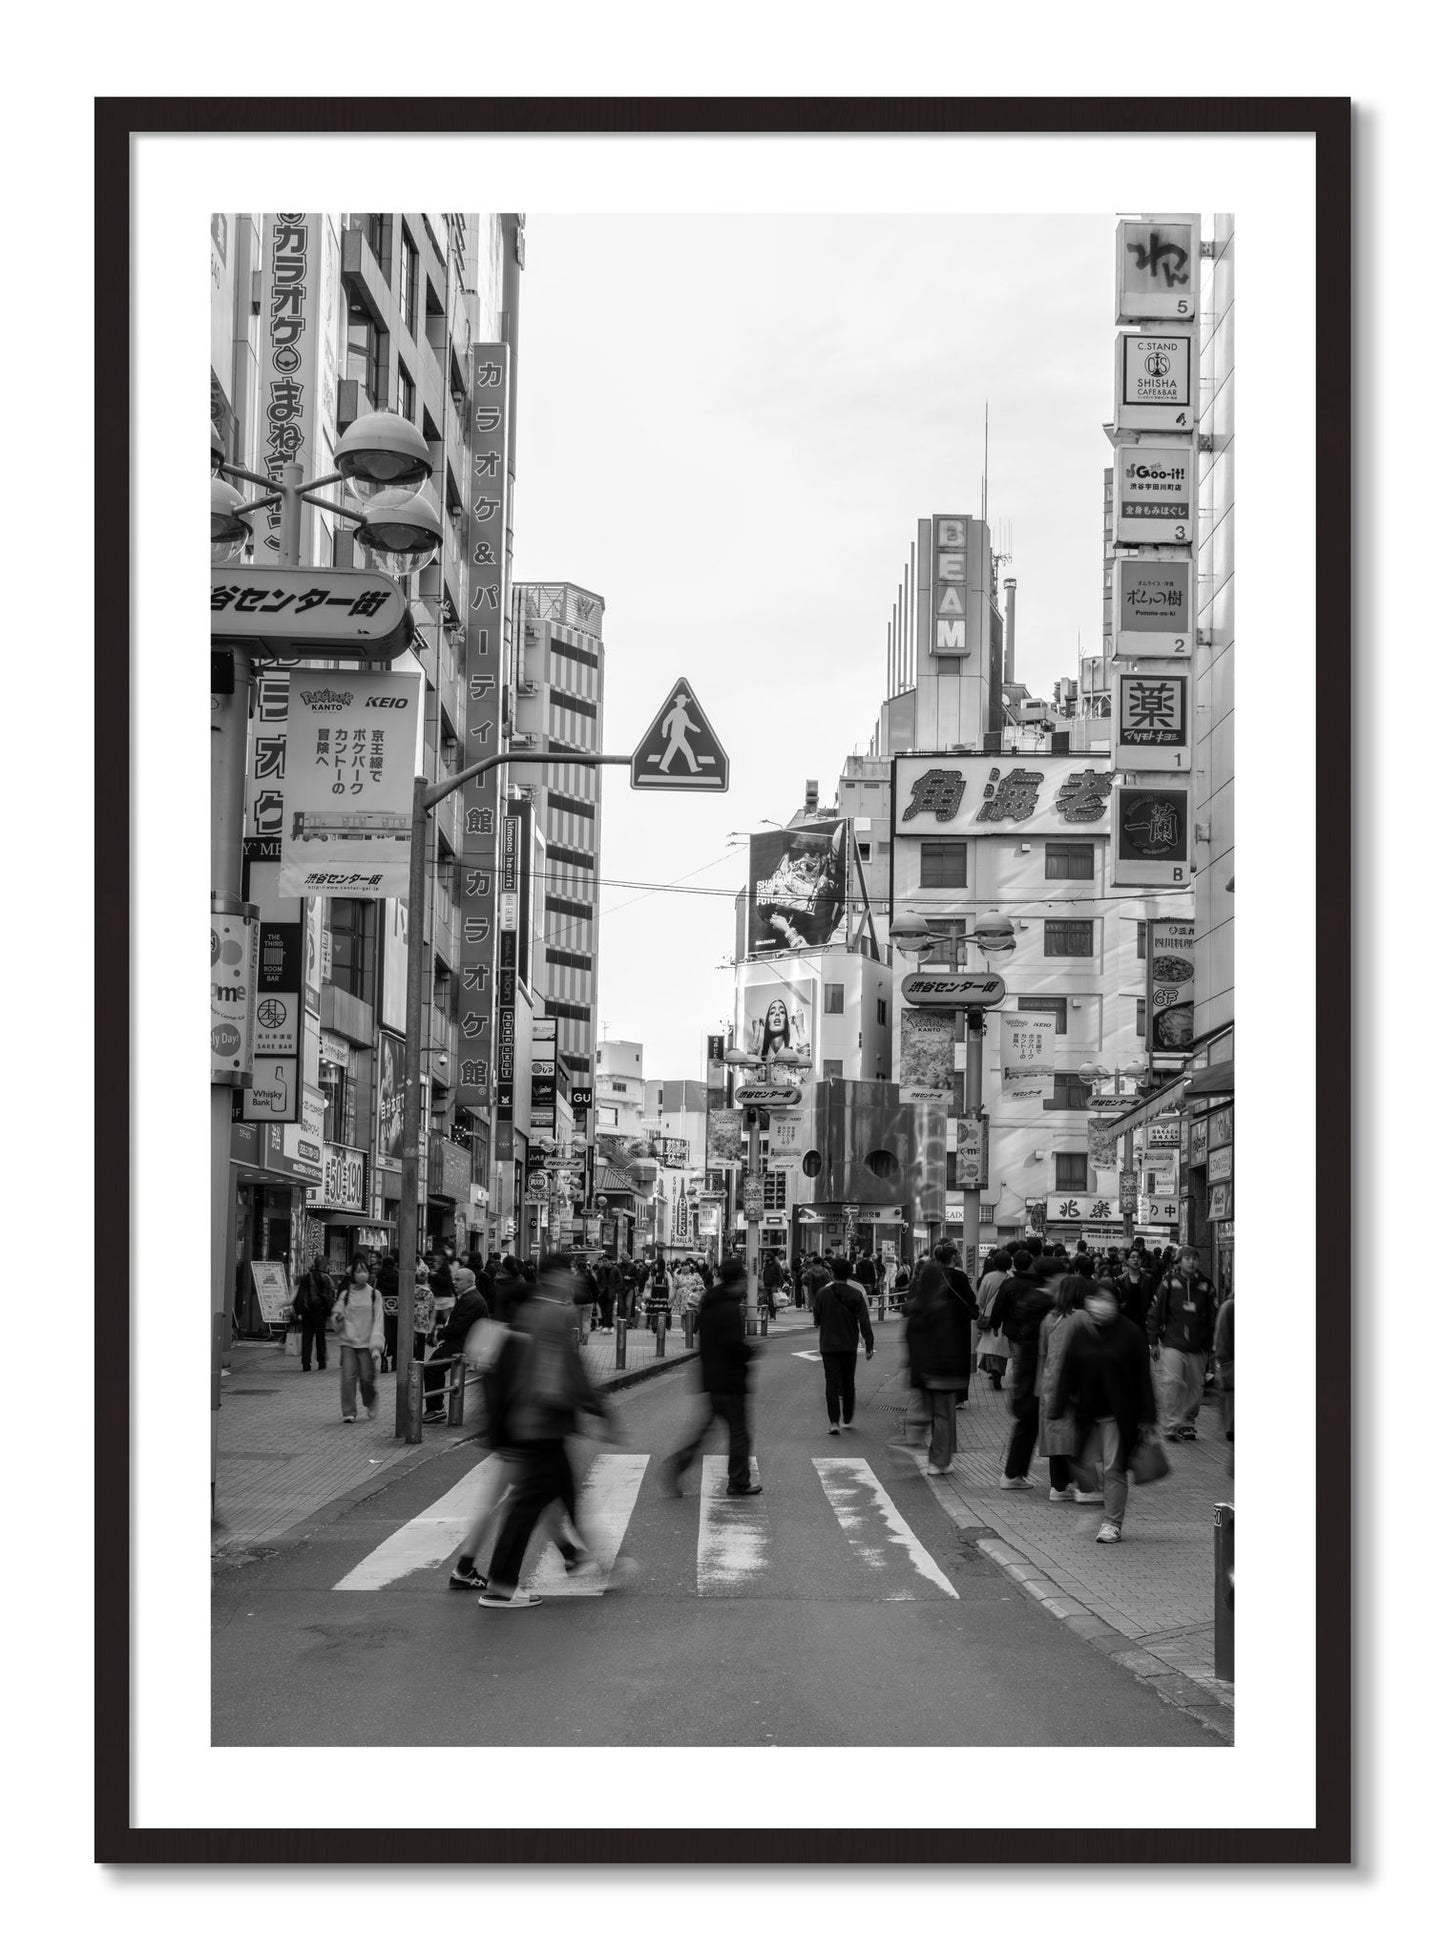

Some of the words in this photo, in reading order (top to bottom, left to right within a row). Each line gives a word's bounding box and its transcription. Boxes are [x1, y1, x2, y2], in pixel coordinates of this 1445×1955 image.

[1177, 300, 1188, 313] 5
[1137, 342, 1178, 351] C.STAND
[1137, 378, 1177, 388] SHISHA
[1137, 388, 1177, 396] CAFE&BAR
[1176, 412, 1187, 426] 4
[1125, 504, 1186, 516] 全身もみほぐし
[1175, 526, 1186, 540] 3
[938, 520, 966, 648] BEAM
[1174, 638, 1185, 654] 2
[365, 696, 408, 709] KEIO
[1129, 682, 1174, 727] 薬
[316, 728, 331, 767] 冒険へ
[332, 728, 348, 794] カントーの
[350, 728, 366, 795] ポケパーク
[369, 729, 385, 782] 京王線で
[1173, 752, 1182, 767] 1
[902, 768, 1112, 822] 角海老
[303, 873, 383, 884] 渋谷センター街
[1172, 866, 1184, 881] B
[908, 980, 1001, 993] 渋谷センター街
[1153, 988, 1179, 1006] 6F
[252, 1089, 283, 1100] Whisky
[573, 1093, 591, 1103] GU
[252, 1099, 271, 1107] Bank
